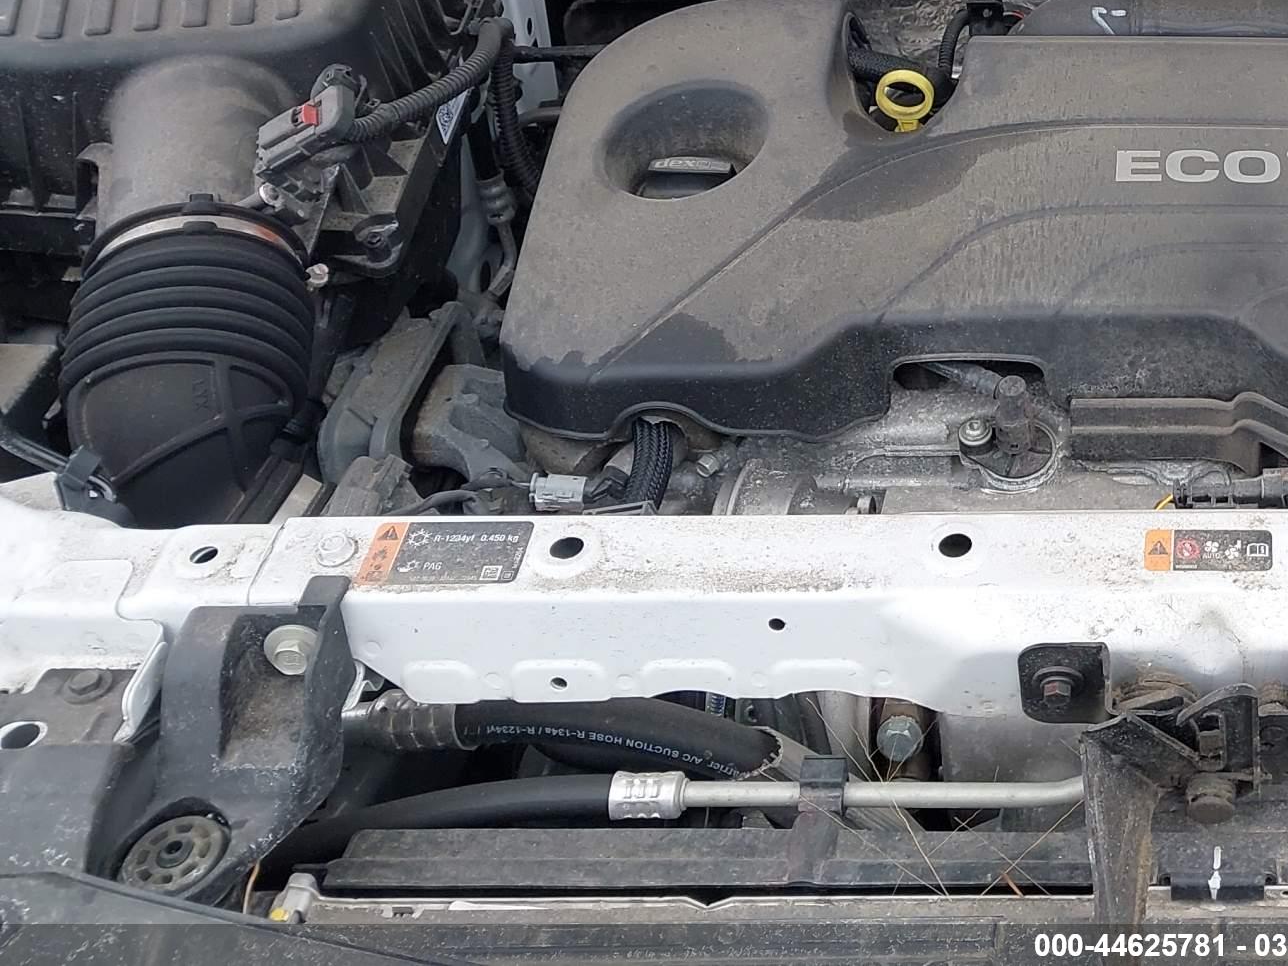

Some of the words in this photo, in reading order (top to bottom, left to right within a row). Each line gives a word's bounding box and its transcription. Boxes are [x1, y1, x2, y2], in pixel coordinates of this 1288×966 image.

[481, 534, 505, 542] 0.450
[508, 534, 519, 543] kg
[423, 562, 443, 570] PAG
[545, 726, 585, 740] R-134a
[589, 731, 623, 746] HOSE
[625, 738, 679, 758] SUCTION
[681, 753, 704, 765] A/C
